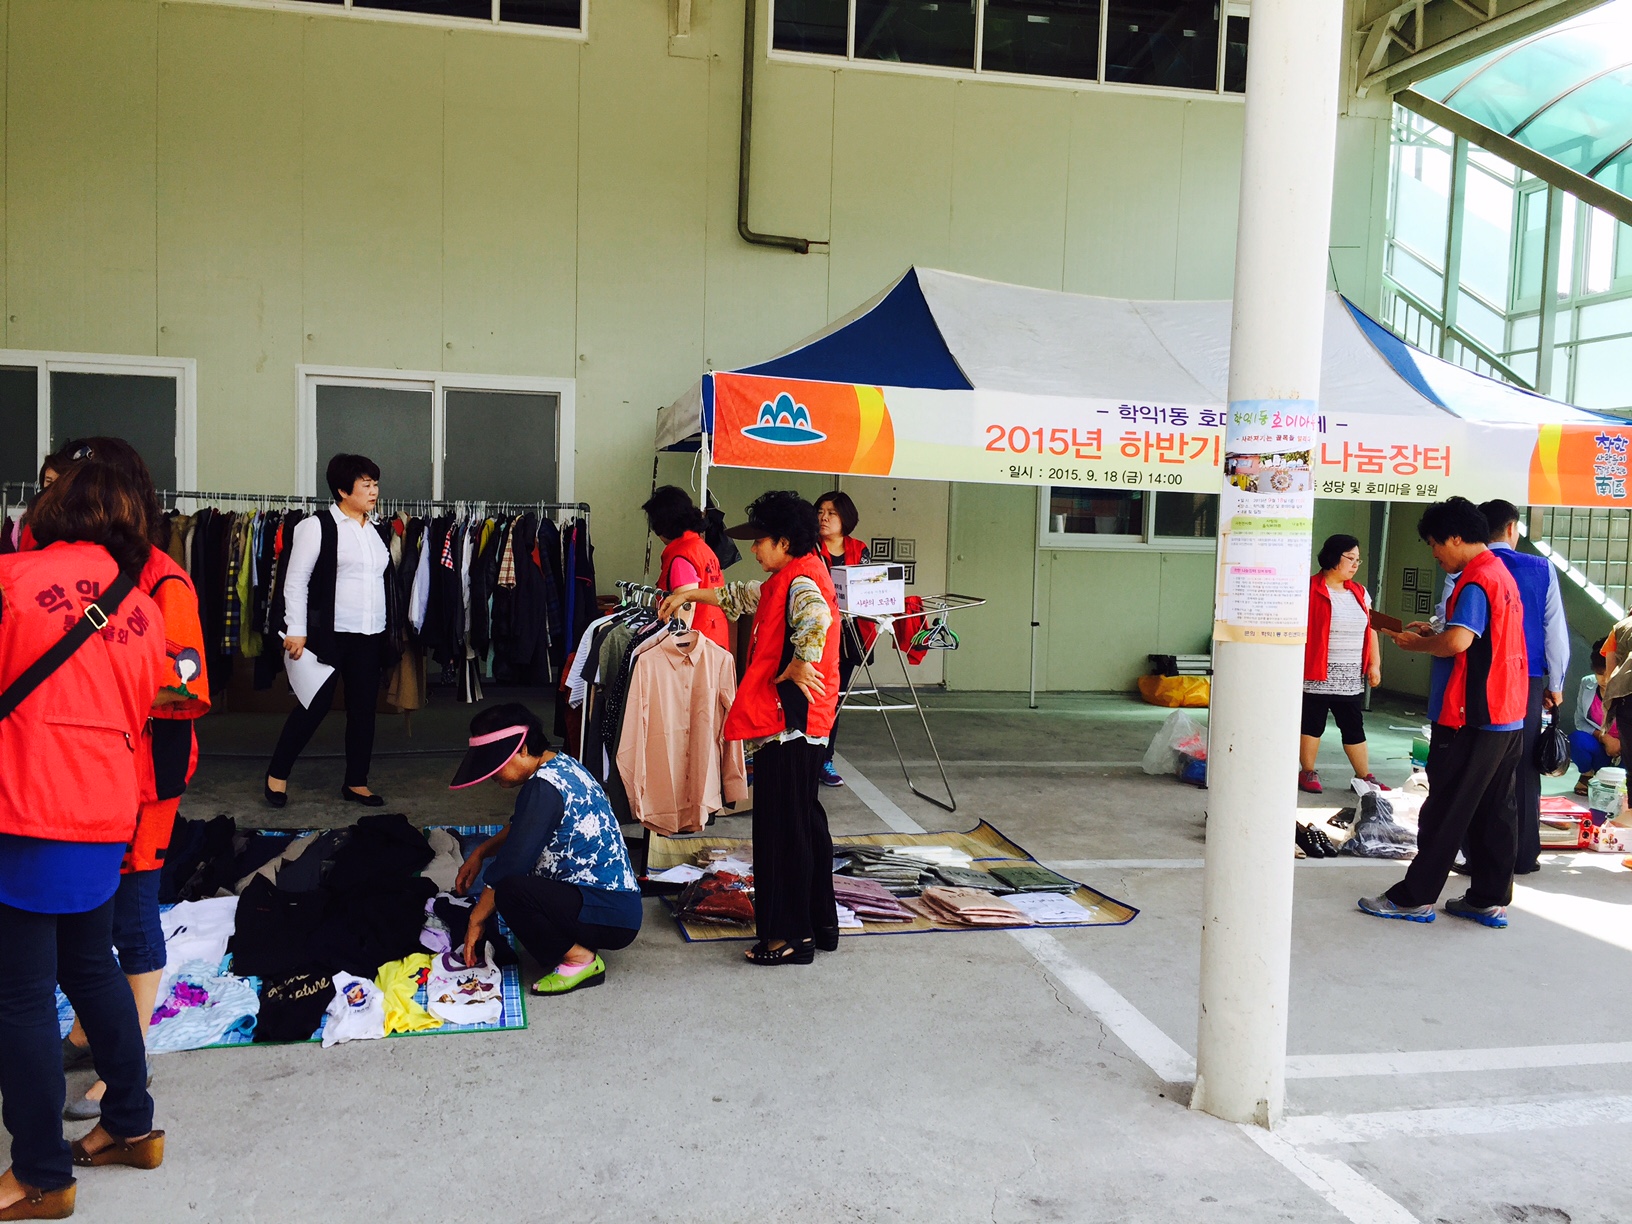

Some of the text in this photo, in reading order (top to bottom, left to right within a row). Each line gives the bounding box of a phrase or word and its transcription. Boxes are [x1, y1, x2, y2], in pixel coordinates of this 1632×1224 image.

[1118, 404, 1189, 427] 학익1동
[985, 424, 1451, 477] 2015년 하반기 나눔장터
[1595, 431, 1629, 452] 착한
[1008, 465, 1034, 479] 일시
[1048, 468, 1082, 481] 2015.
[1103, 470, 1118, 482] 18
[1121, 470, 1143, 485] (금)
[1148, 472, 1183, 485] 14:00
[1322, 480, 1346, 493] 성당
[1350, 481, 1361, 494] 및
[1365, 482, 1412, 496] 호미마을
[1416, 484, 1438, 497] 일원
